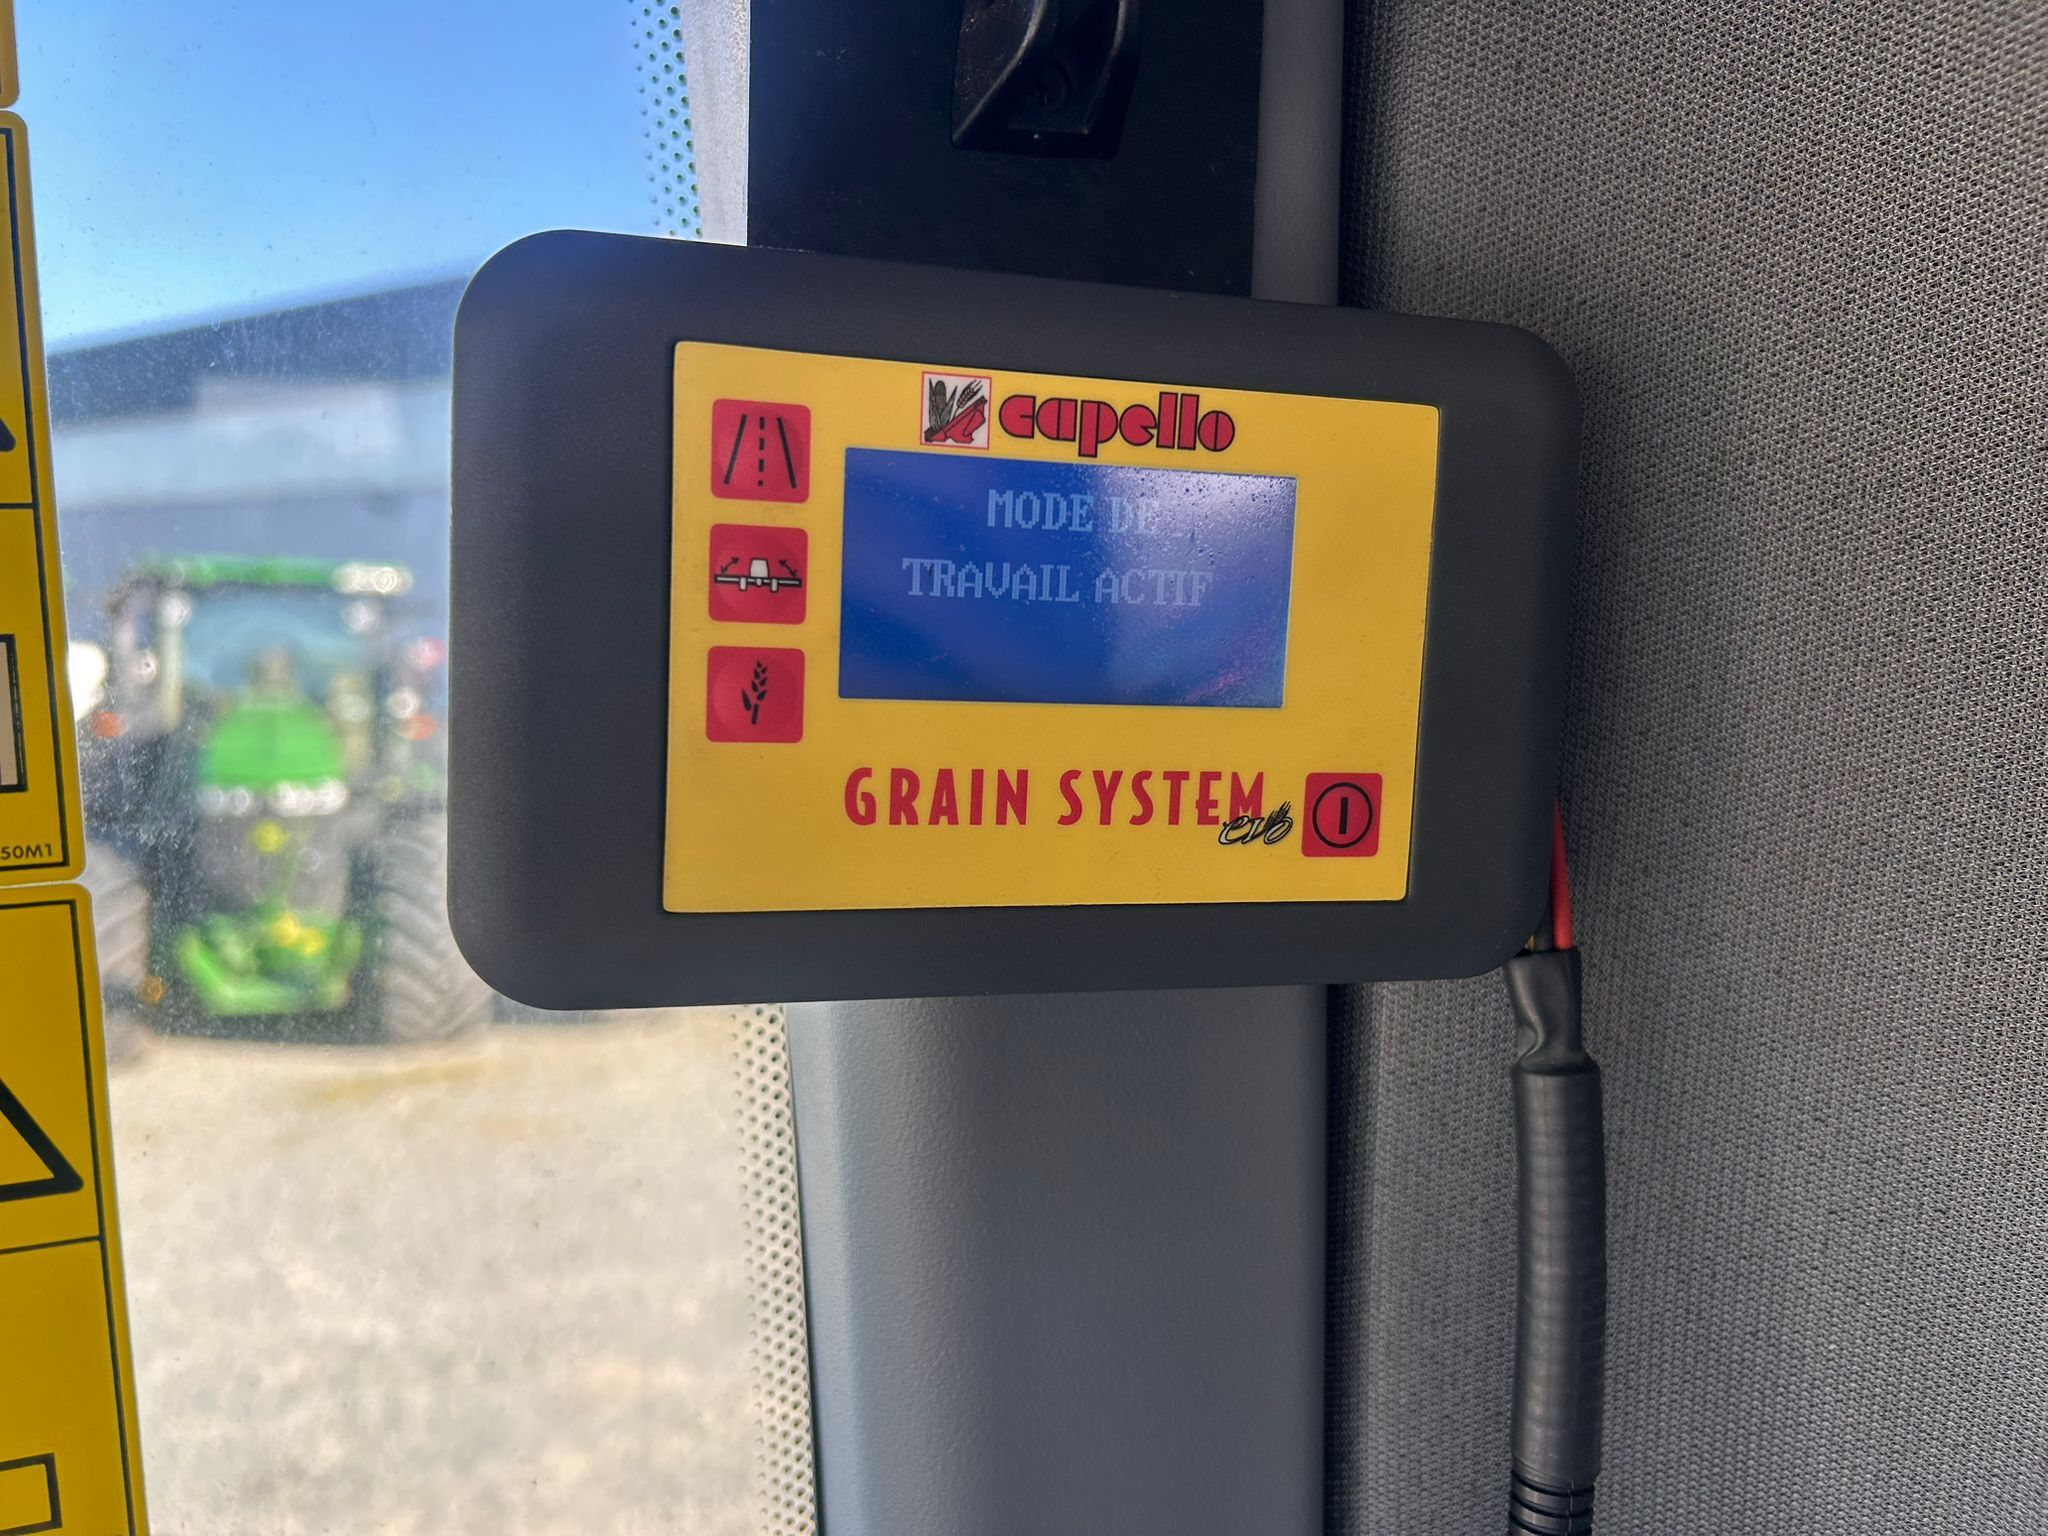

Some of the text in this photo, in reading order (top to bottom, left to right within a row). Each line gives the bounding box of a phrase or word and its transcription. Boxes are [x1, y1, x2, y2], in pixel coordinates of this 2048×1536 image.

[999, 391, 1235, 458] capello
[987, 489, 1093, 532] MODE
[902, 557, 1213, 606] TRAVAIL ACTIF
[844, 767, 1264, 826] GRAIN SYSTEM
